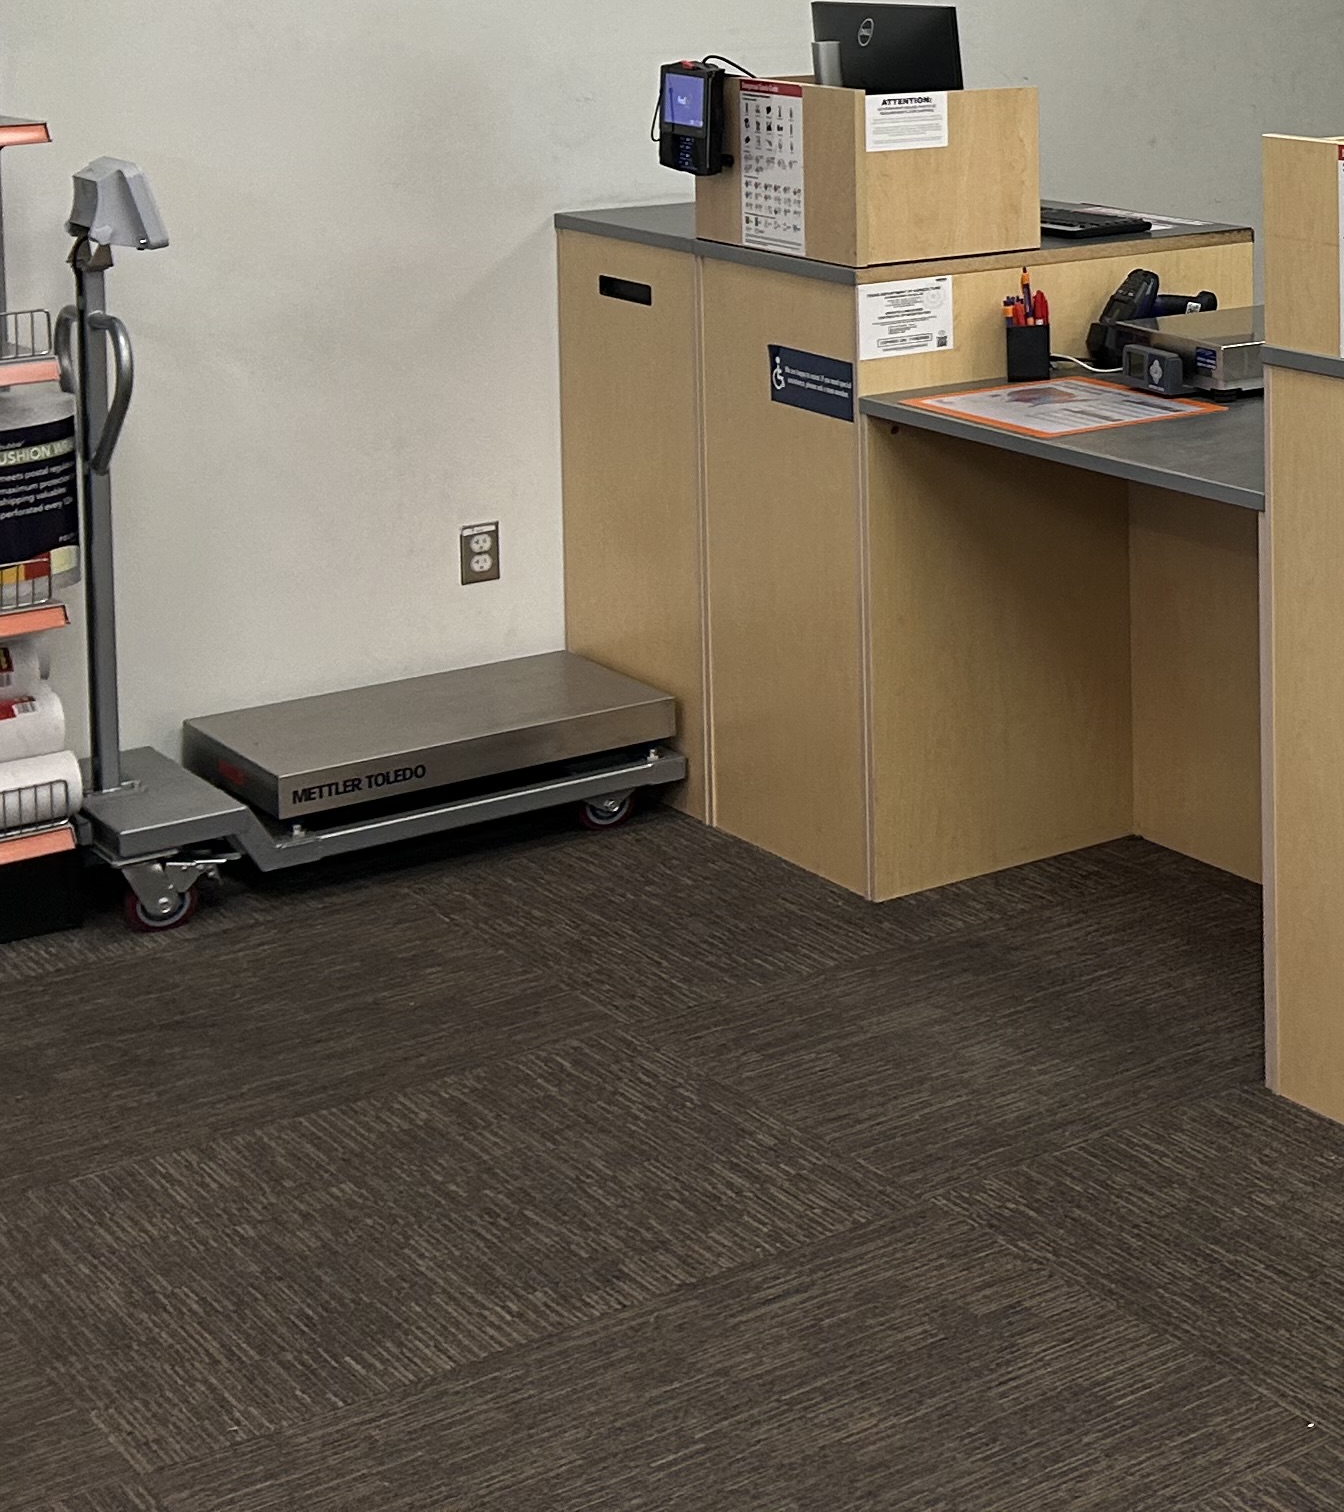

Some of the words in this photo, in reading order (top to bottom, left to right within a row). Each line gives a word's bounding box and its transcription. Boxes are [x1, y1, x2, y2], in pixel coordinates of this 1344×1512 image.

[0, 446, 51, 465] USHION
[292, 777, 362, 804] METTLER
[365, 764, 426, 788] TOLEDO
